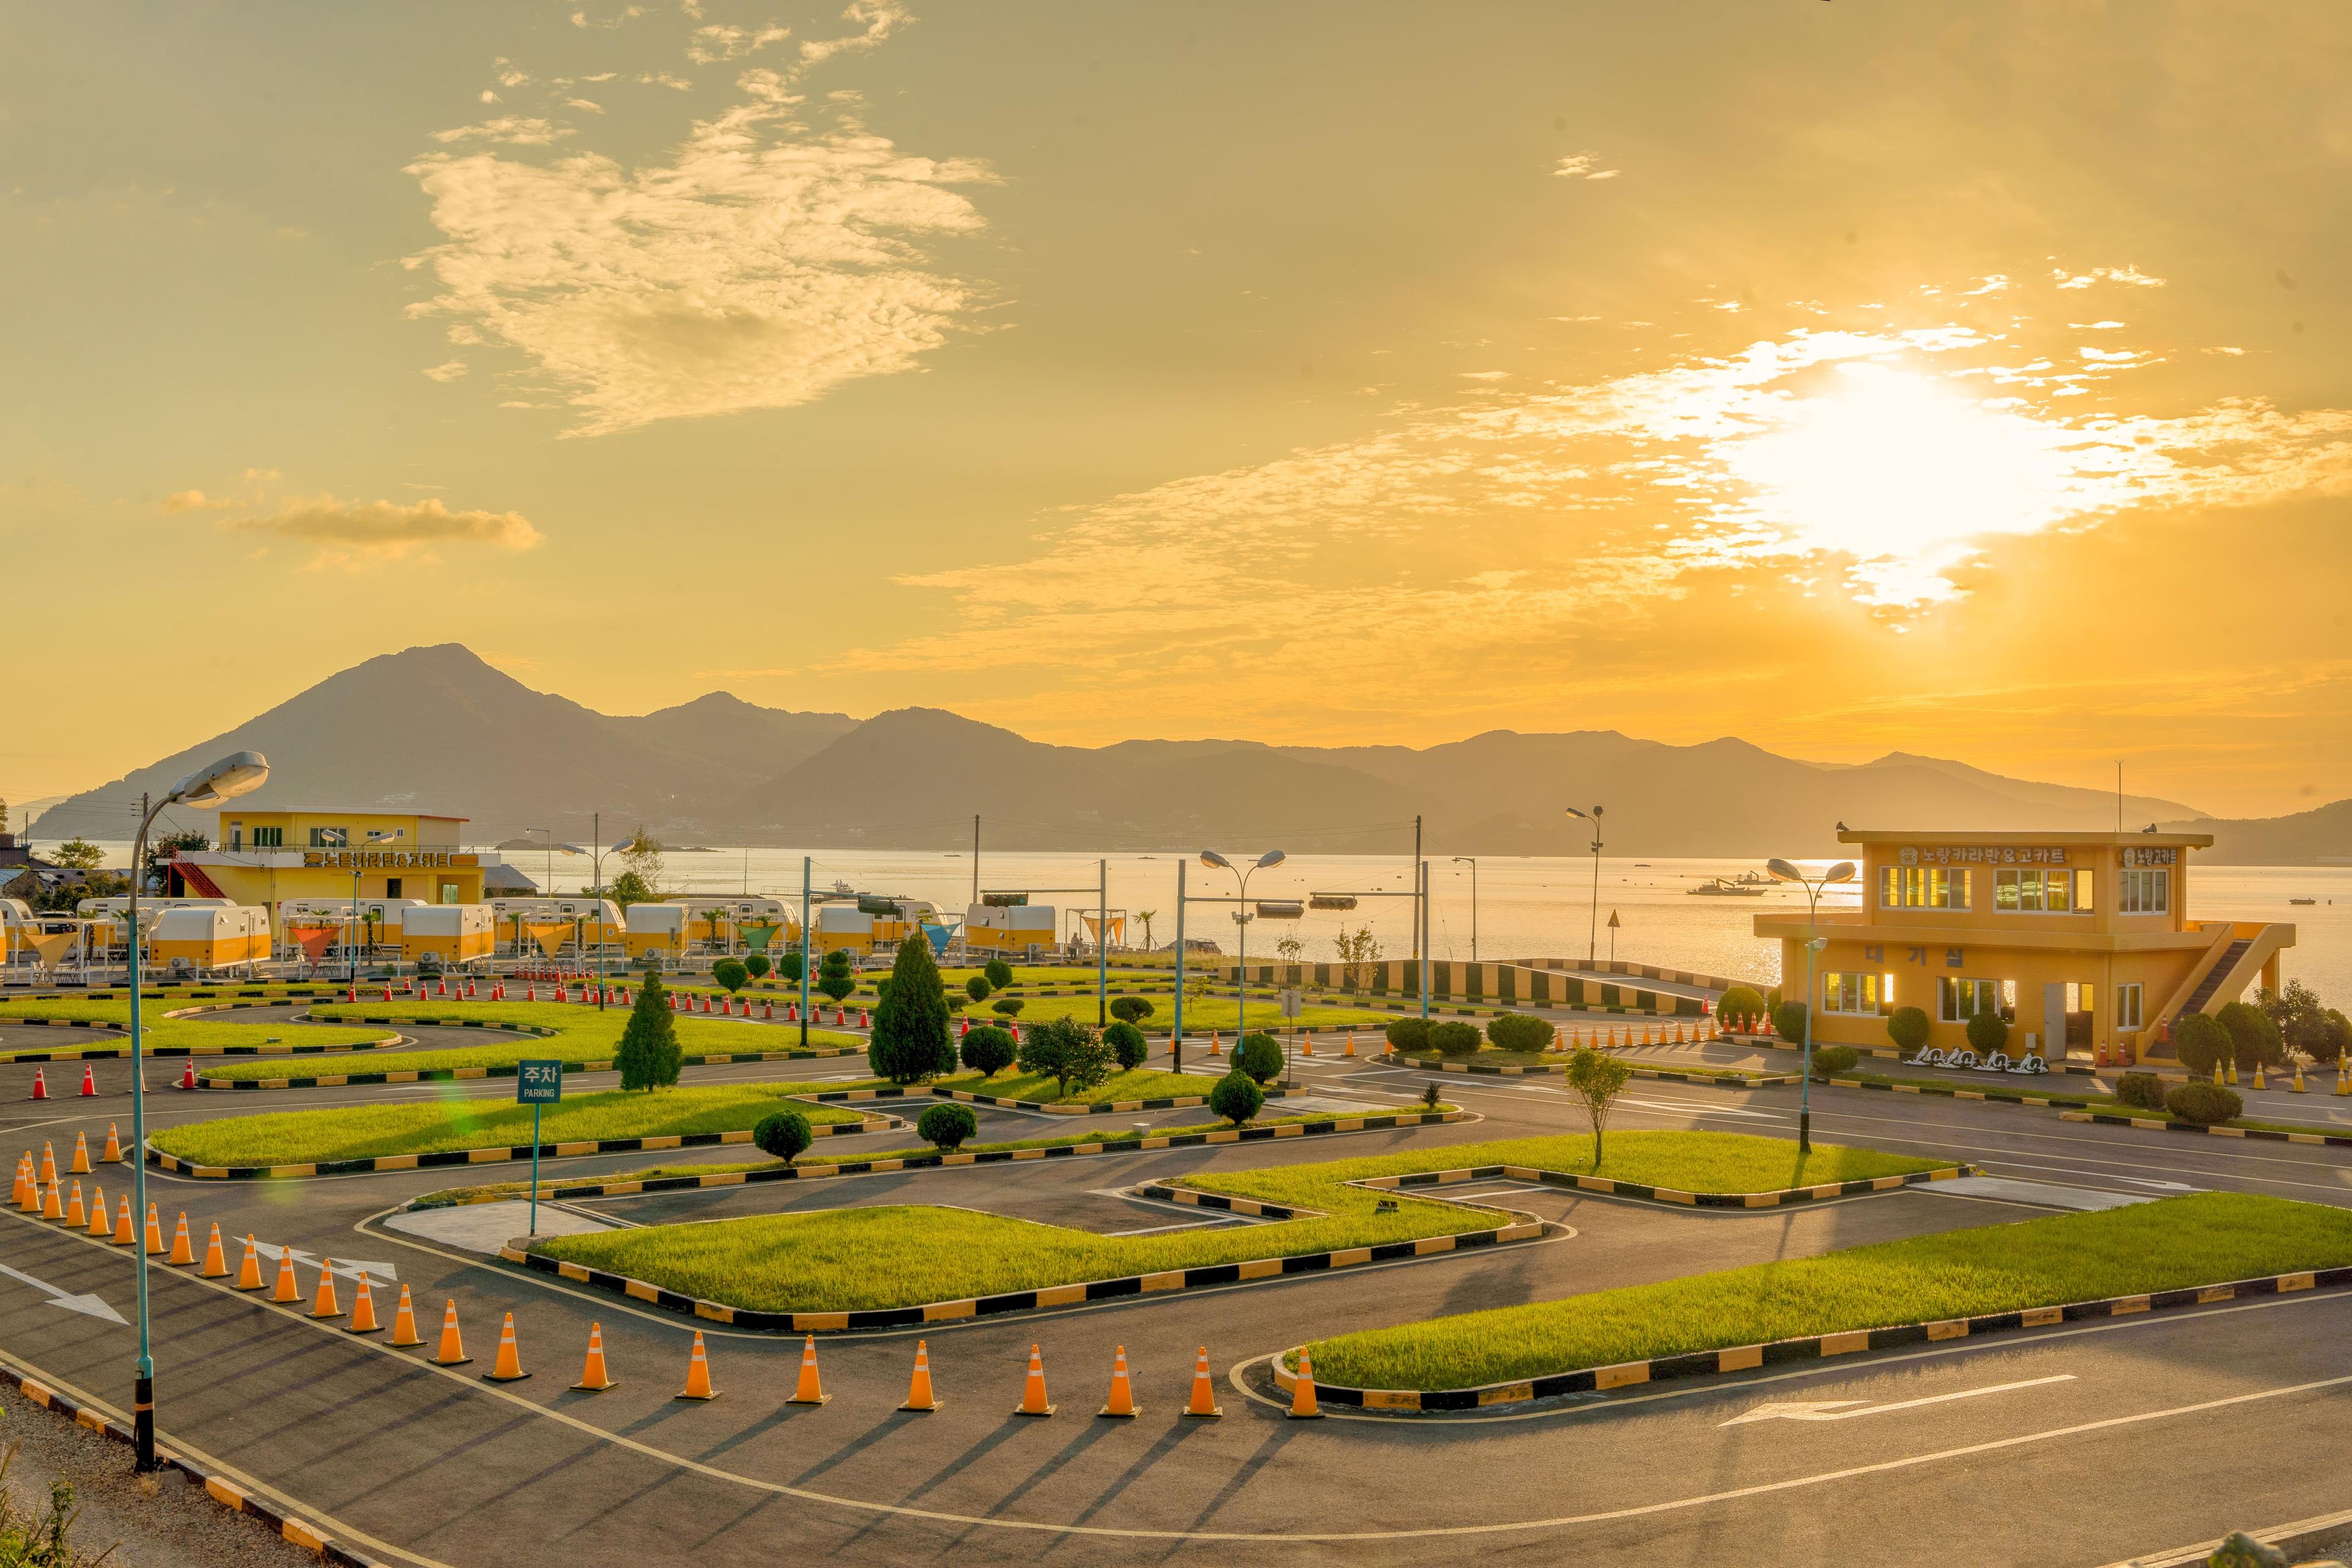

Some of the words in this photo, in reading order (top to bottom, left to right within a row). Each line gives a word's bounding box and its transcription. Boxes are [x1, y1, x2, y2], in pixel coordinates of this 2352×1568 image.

[2137, 848, 2177, 866] 노랑고카트
[1866, 944, 1962, 968] 대기실
[524, 1067, 557, 1083] 주차
[524, 1088, 554, 1098] PARKING
